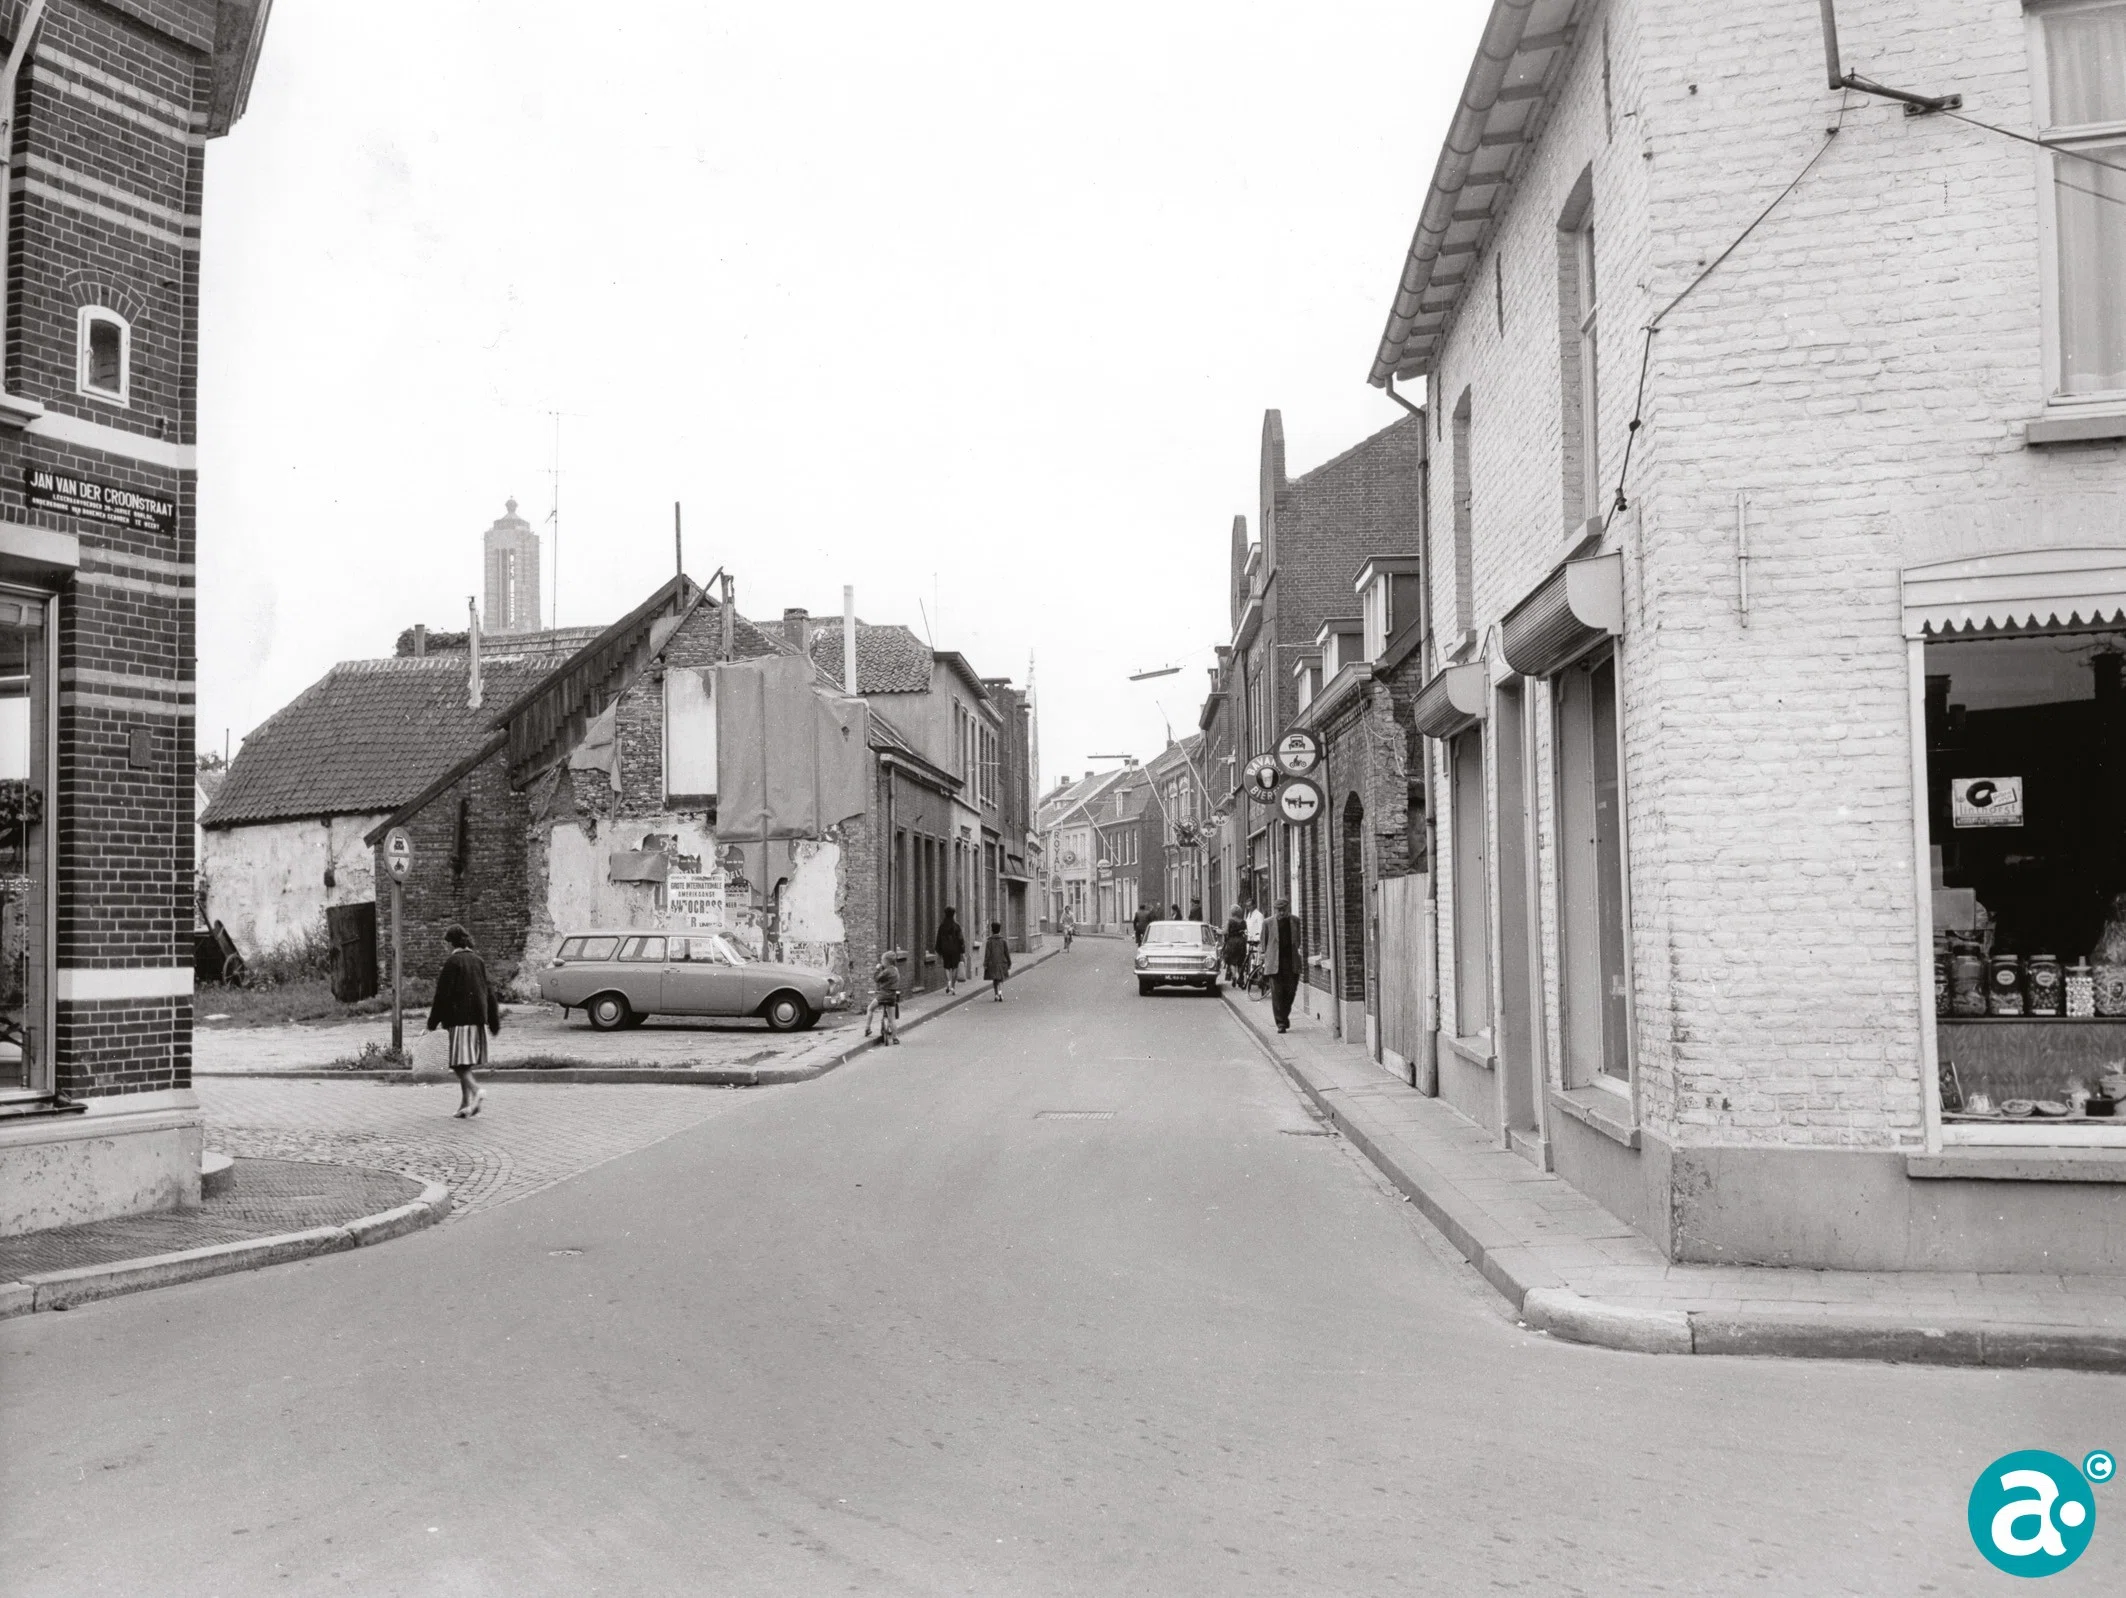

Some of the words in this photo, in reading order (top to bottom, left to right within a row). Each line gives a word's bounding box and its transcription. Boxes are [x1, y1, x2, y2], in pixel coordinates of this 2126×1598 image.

[30, 471, 53, 491] JAN
[55, 476, 77, 496] VAN
[79, 482, 101, 501] DER
[104, 487, 173, 517] CROONSTRAAT
[135, 519, 142, 527] TE
[671, 882, 685, 890] GROTE
[686, 882, 723, 890] INTERNATIONALE
